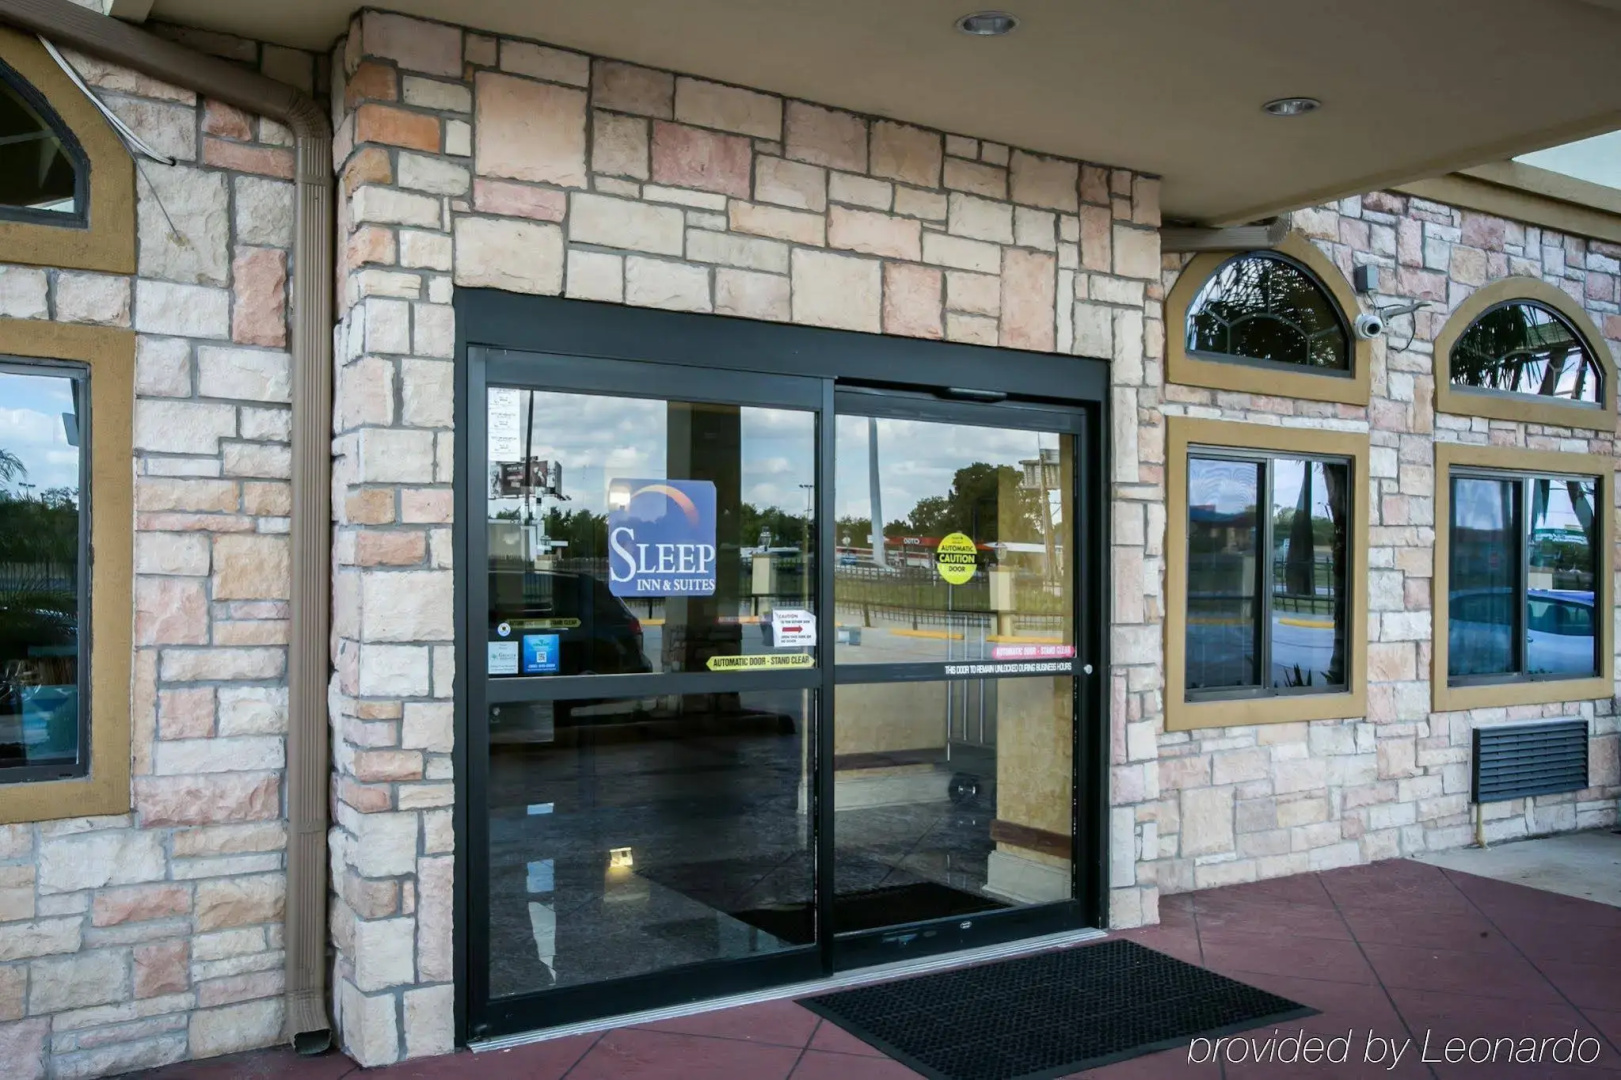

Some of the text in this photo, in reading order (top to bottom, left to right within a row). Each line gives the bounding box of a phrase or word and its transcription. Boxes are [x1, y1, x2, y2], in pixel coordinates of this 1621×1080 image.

[610, 527, 716, 582] SLEEP
[940, 554, 975, 563] CAUTION
[637, 579, 716, 591] INN & SUITES
[713, 658, 749, 667] AUTOMATIC
[749, 657, 766, 666] DOOR
[771, 656, 791, 665] STAND
[791, 655, 810, 664] CLEAR
[945, 665, 956, 674] THIS
[957, 665, 969, 674] DOOR
[970, 665, 977, 674] TO
[1036, 663, 1056, 671] BUSINESS
[1057, 662, 1072, 671] HOURS
